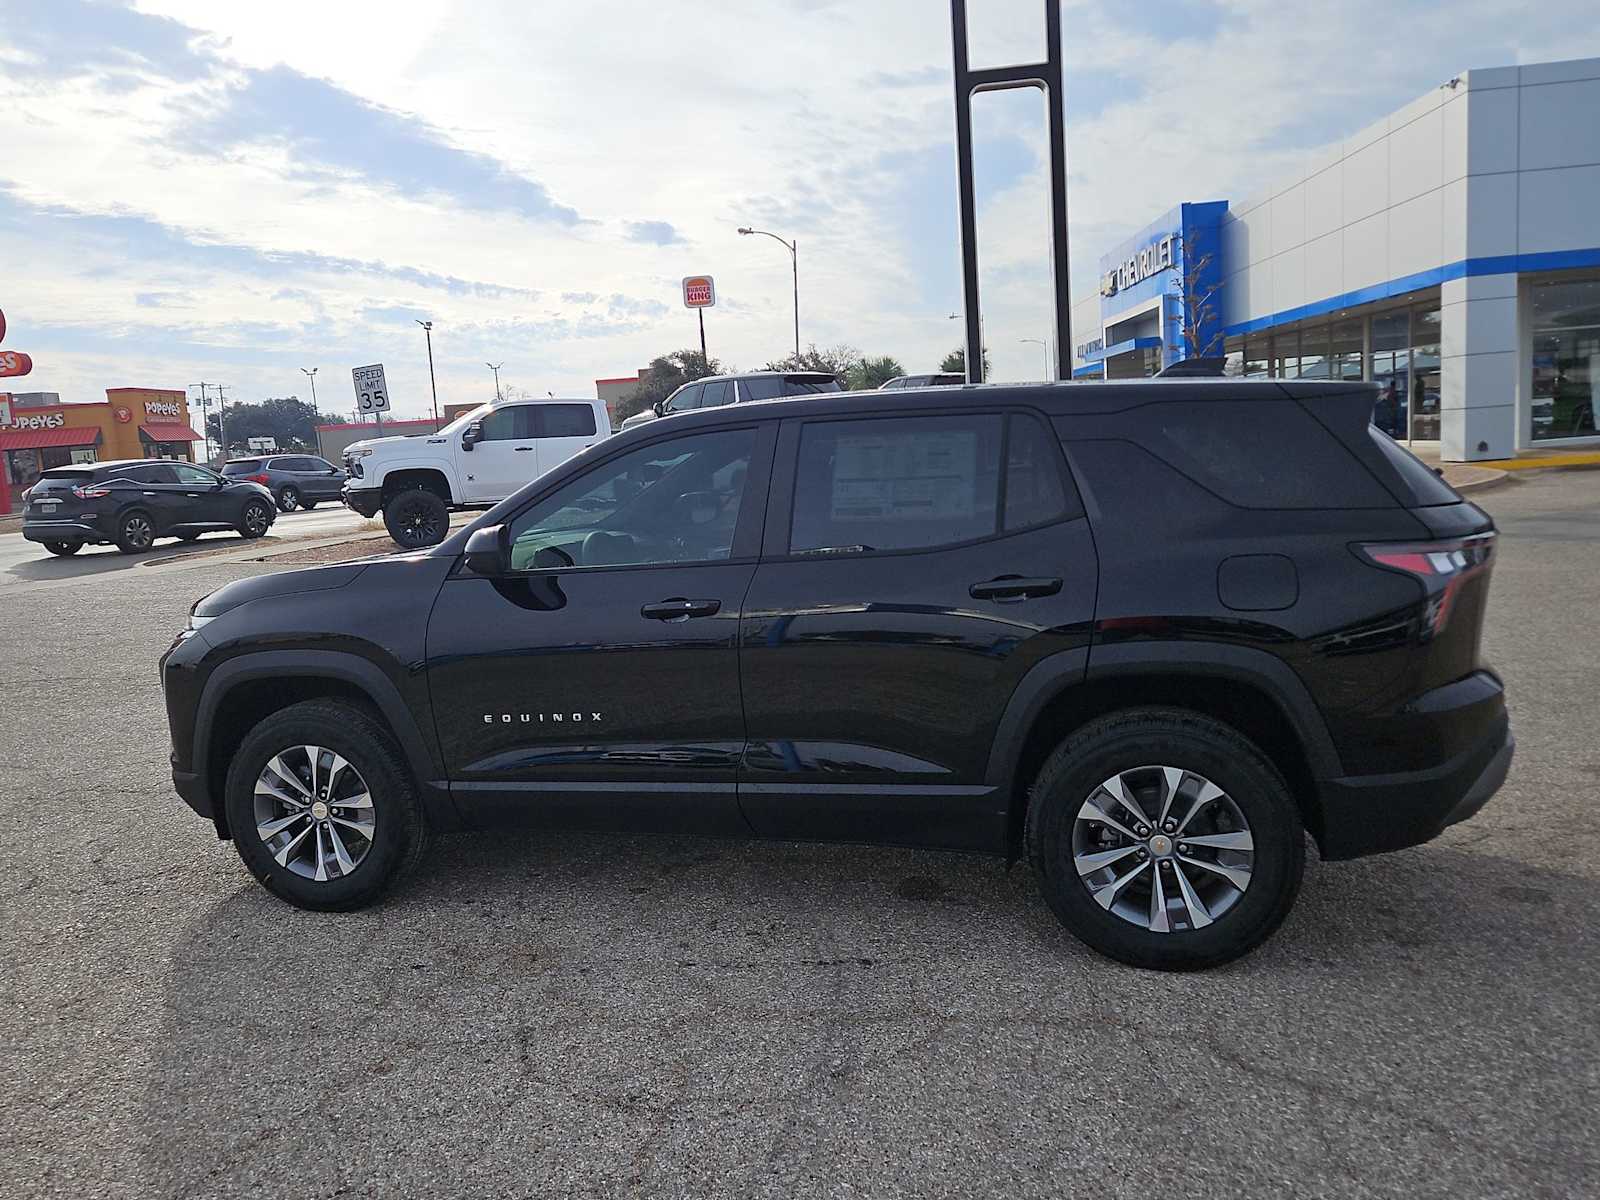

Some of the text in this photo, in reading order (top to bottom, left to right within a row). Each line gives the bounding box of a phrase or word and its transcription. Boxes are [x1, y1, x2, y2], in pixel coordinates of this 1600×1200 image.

[1117, 234, 1174, 290] CHEVROLET
[687, 292, 711, 301] KING
[354, 369, 382, 381] SPEED
[360, 380, 380, 391] LIMIT
[361, 390, 386, 409] 35
[145, 401, 181, 416] POPEYES
[483, 712, 602, 723] EQUINOX
